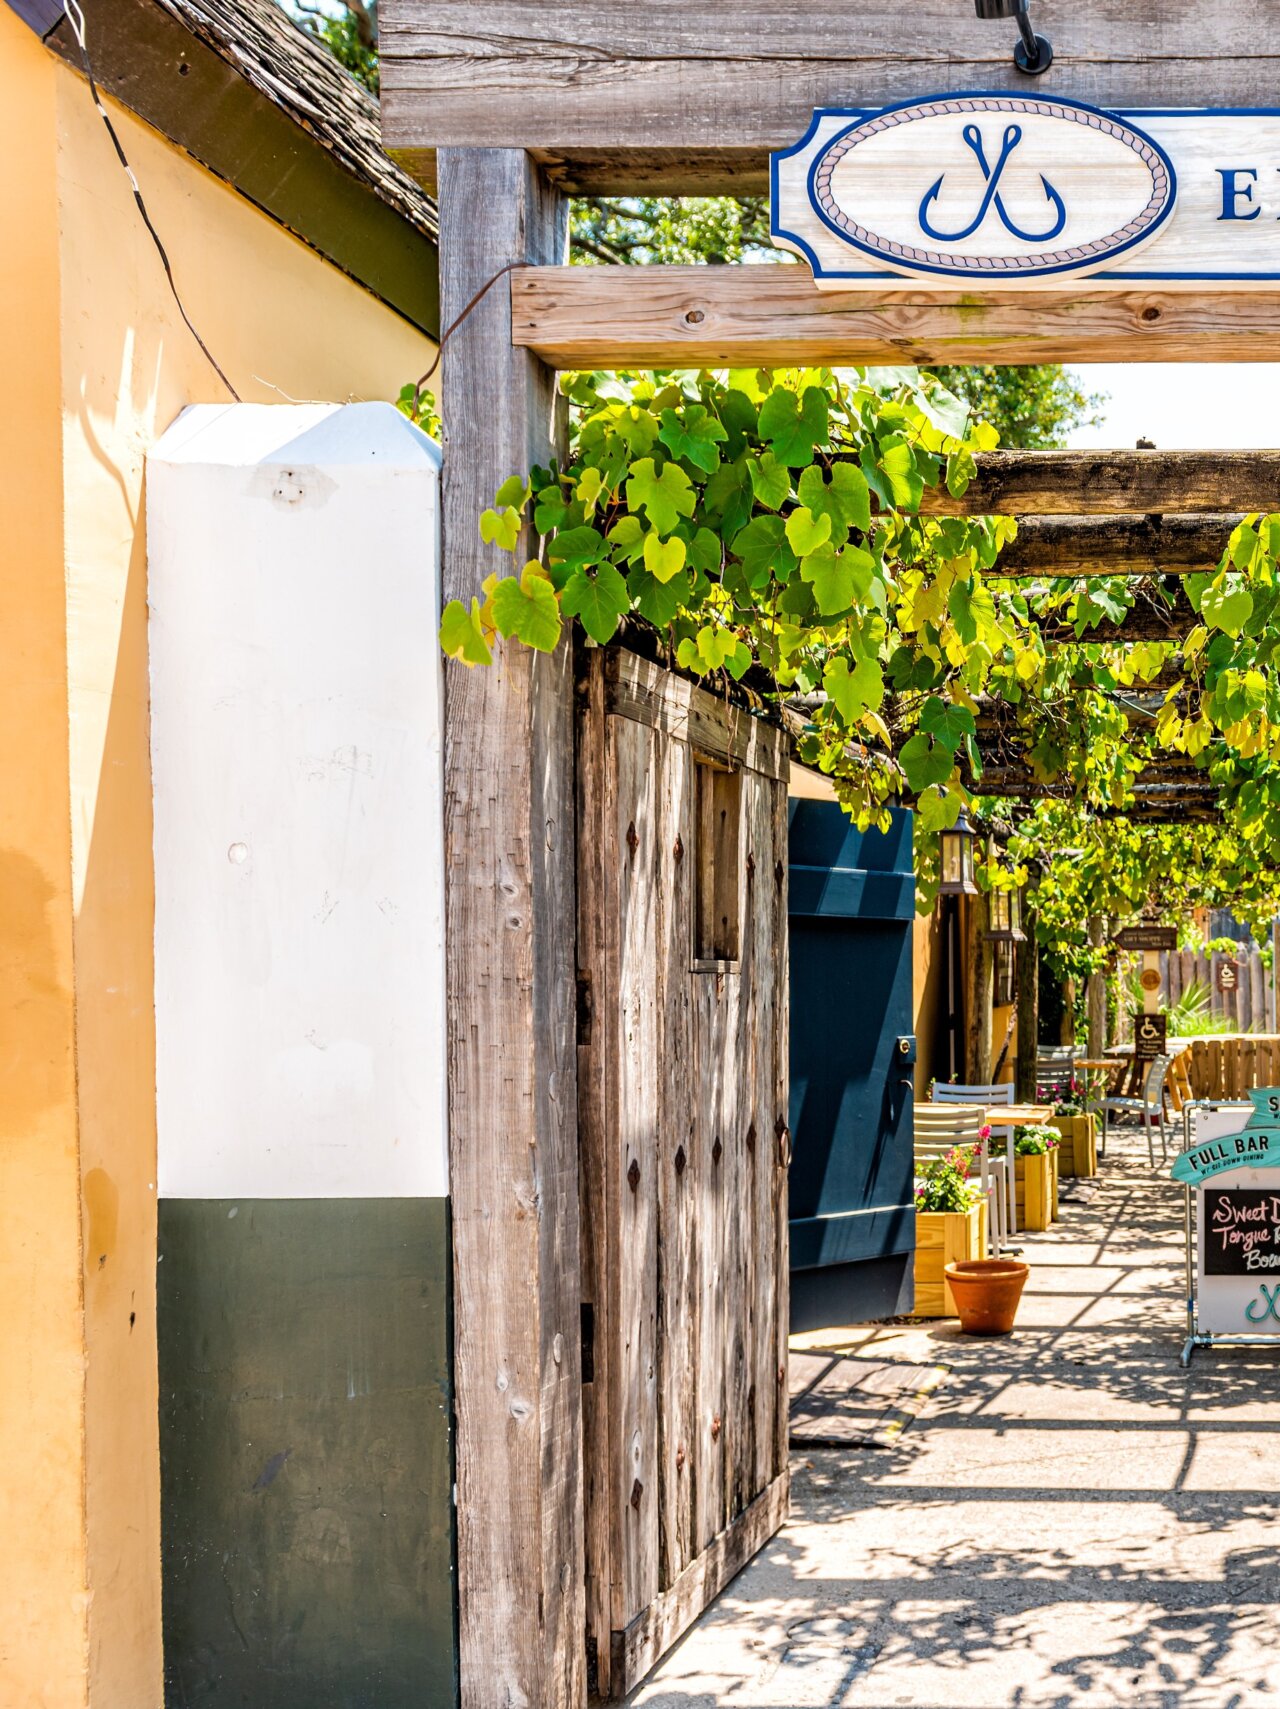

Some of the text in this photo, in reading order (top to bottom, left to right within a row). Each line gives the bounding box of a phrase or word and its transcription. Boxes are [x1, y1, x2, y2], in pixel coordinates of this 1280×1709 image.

[1188, 1135, 1269, 1171] FULL BAR
[1223, 1156, 1241, 1167] DOWN
[1243, 1153, 1264, 1162] DINING
[1212, 1196, 1270, 1223] Sweet
[1212, 1224, 1271, 1250] Tongue
